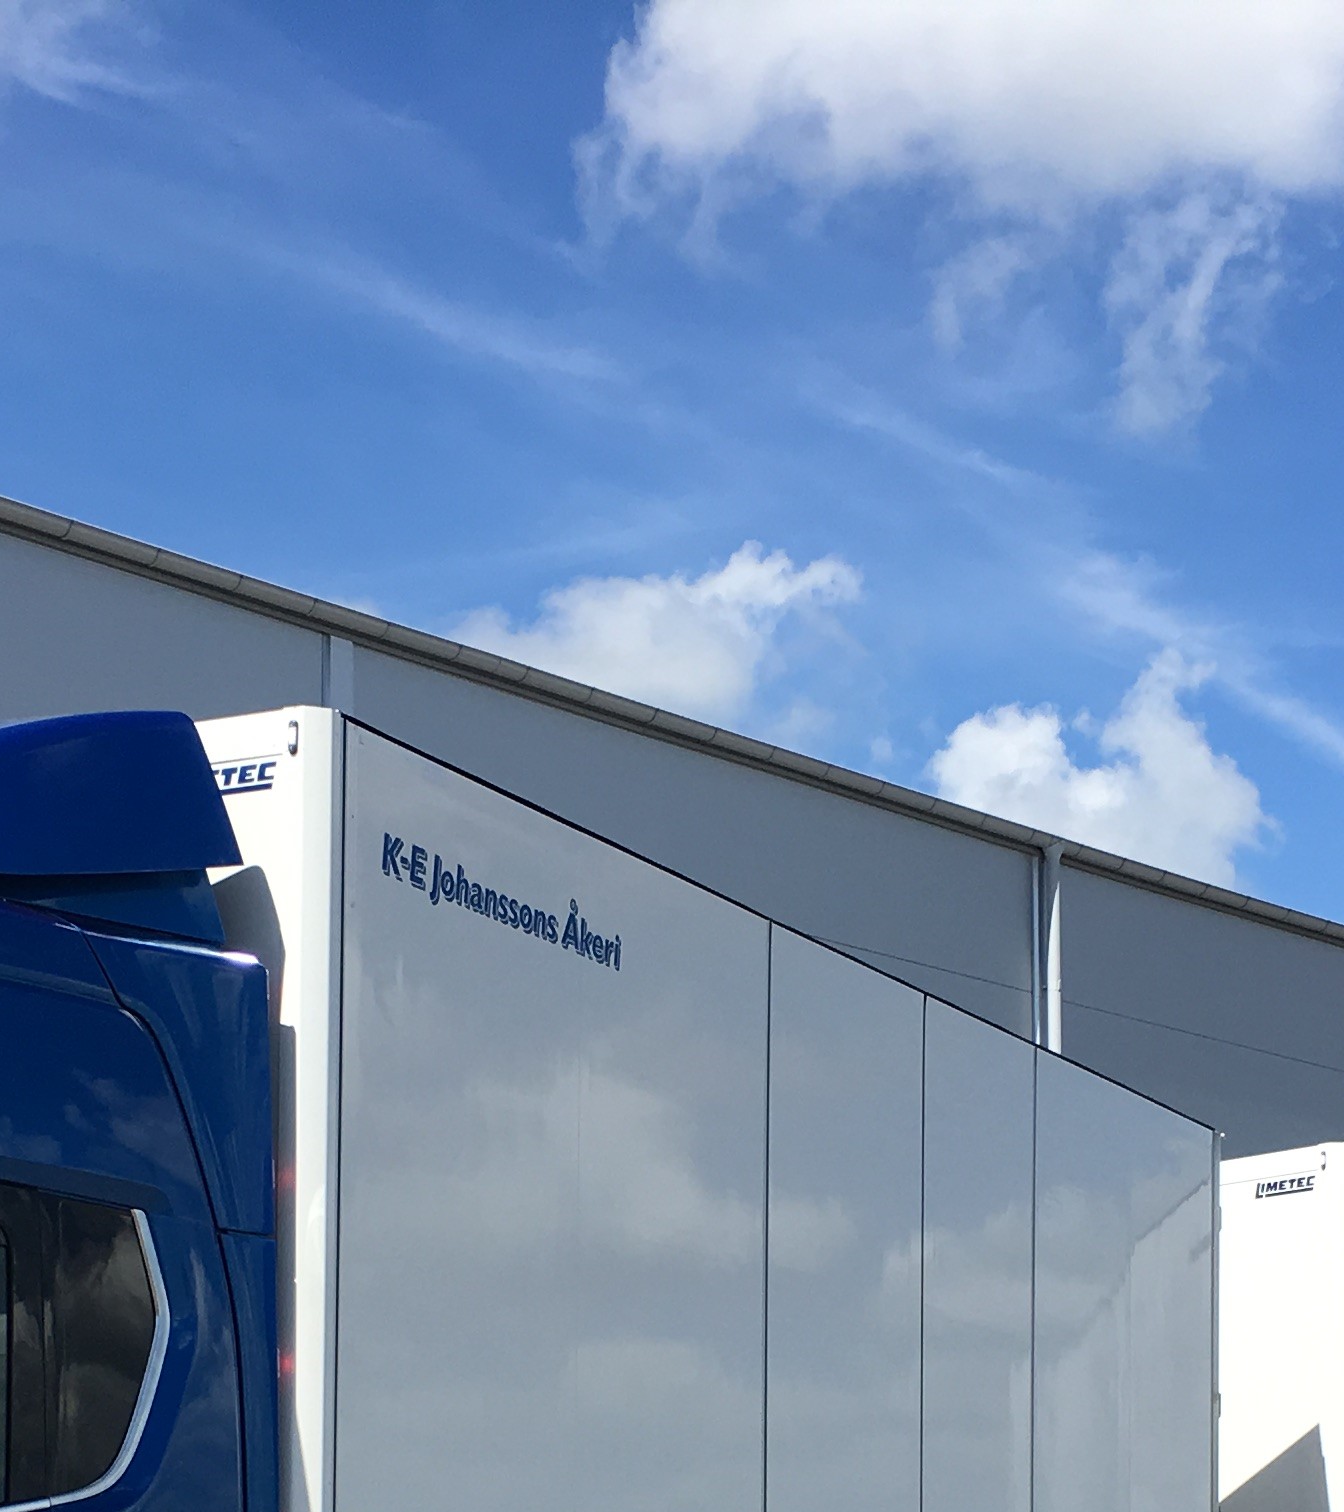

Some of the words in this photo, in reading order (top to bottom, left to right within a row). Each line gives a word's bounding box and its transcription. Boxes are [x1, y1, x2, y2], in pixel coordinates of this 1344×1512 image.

[381, 832, 427, 891] K-E
[429, 854, 558, 944] Johanssons
[561, 898, 621, 971] Åkeri
[1255, 1176, 1315, 1199] LIMETEC
